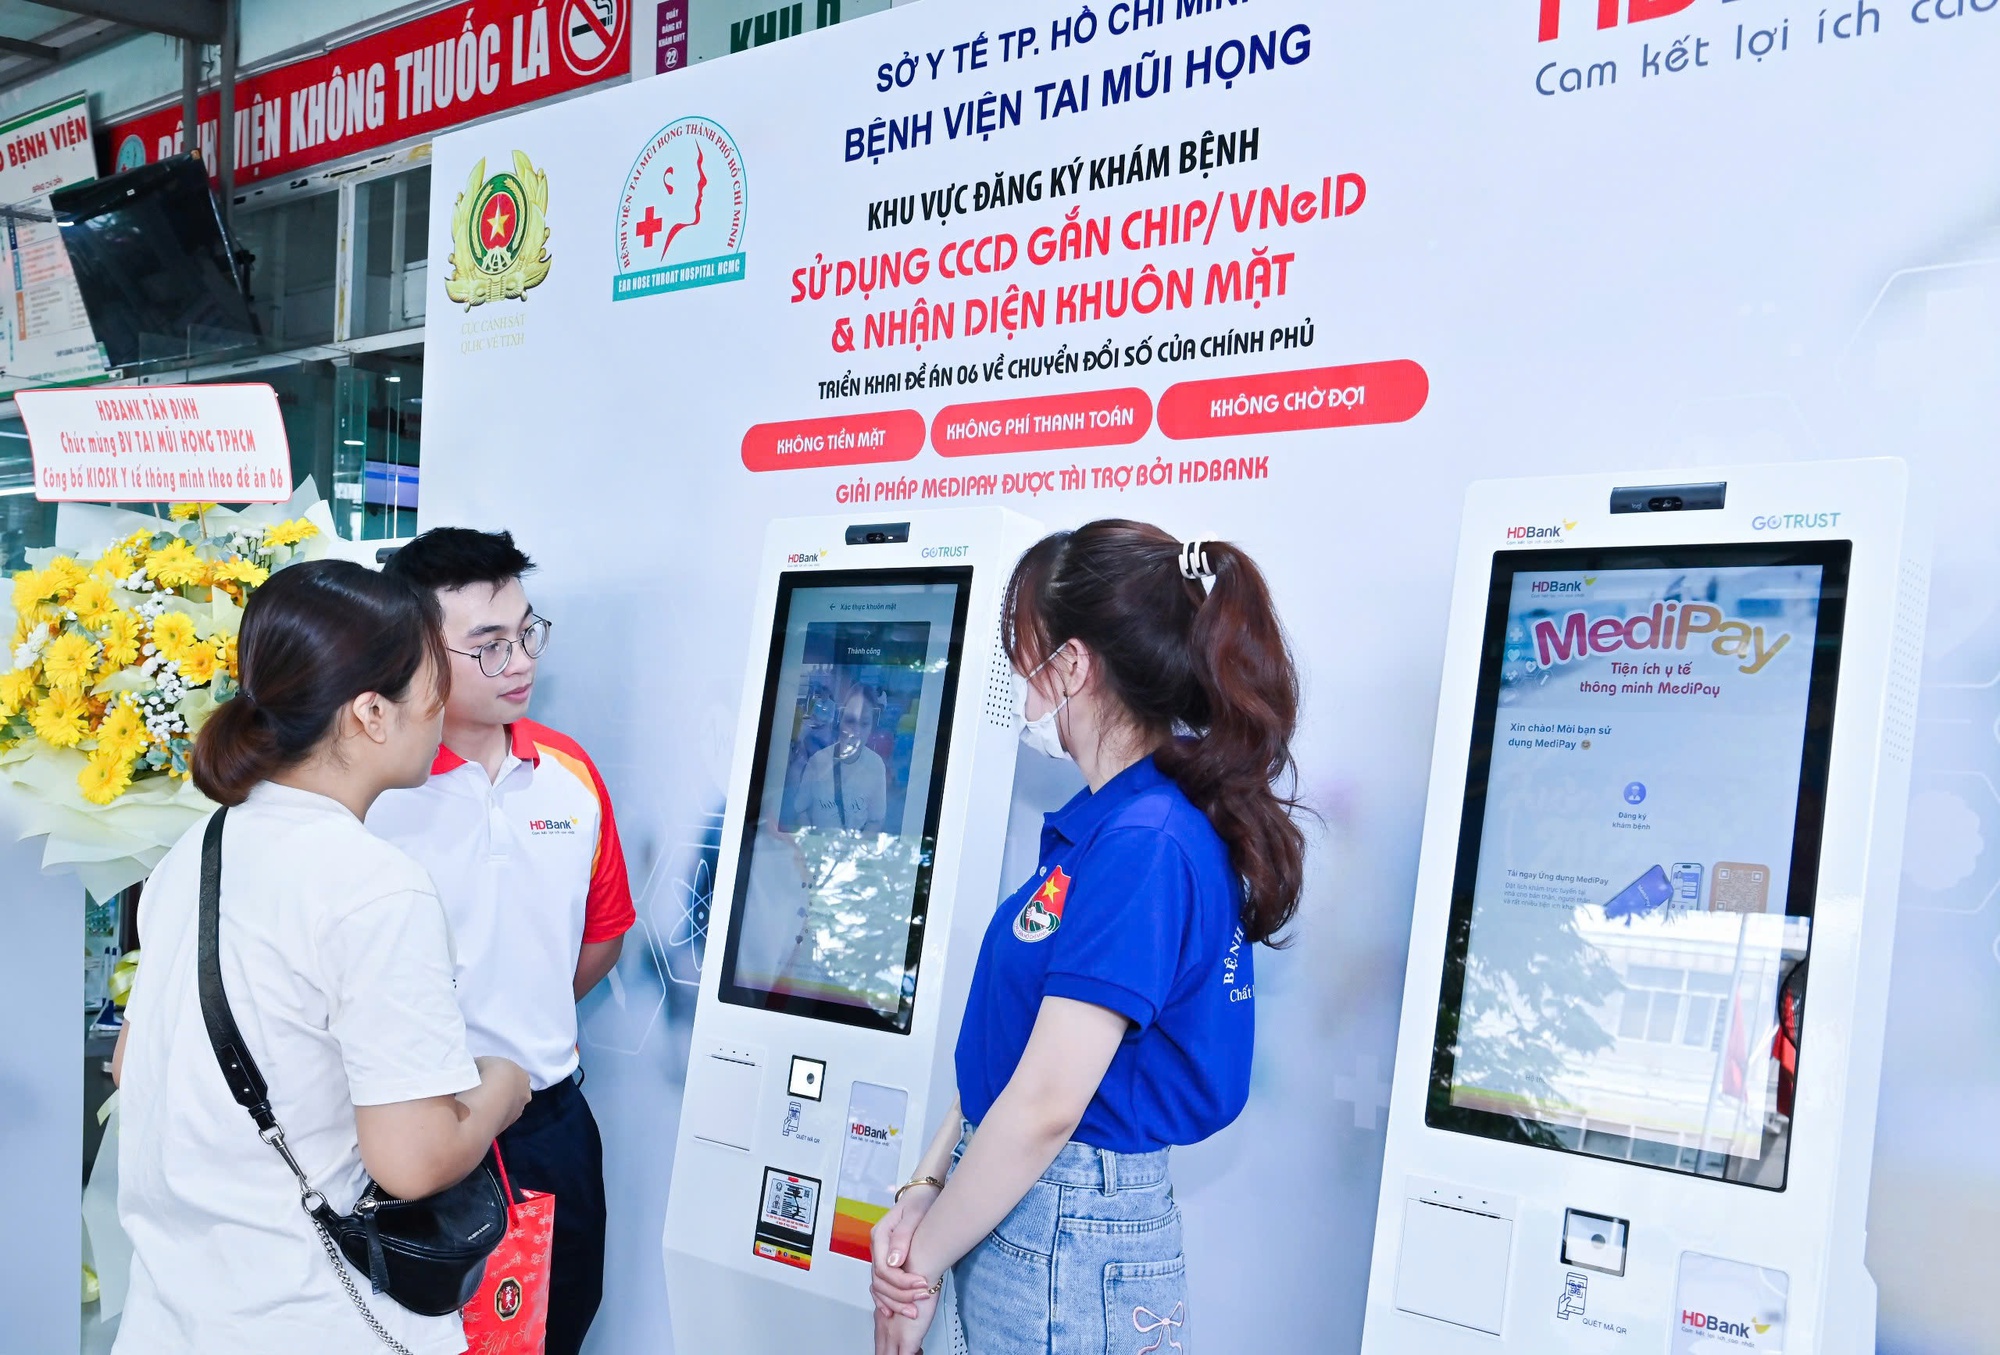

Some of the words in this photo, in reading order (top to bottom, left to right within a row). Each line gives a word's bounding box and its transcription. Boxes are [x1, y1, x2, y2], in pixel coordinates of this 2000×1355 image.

[876, 52, 919, 93] SỞ
[926, 49, 945, 80] Y
[952, 32, 988, 74] TẾ
[998, 27, 1040, 64] TP.
[1051, 4, 1098, 50] HỒ
[1535, 60, 1617, 96] Cam
[1642, 35, 1709, 78] kết
[1735, 18, 1789, 63] lợi
[1817, 0, 1880, 44] ích
[289, 62, 385, 153] KHÔNG
[395, 7, 500, 120] THUỐC
[844, 110, 932, 165] BỆNH
[943, 87, 1022, 142] VIỆN
[1034, 74, 1090, 121] TAI
[1101, 50, 1172, 107] MŨI
[1185, 23, 1312, 91] HỌNG
[7, 131, 48, 170] BỆNH
[49, 115, 87, 152] VIỆN
[657, 126, 683, 149] HỌNG
[685, 122, 716, 142] THÀNH
[628, 169, 642, 193] TAI
[732, 179, 743, 207] CHÍ
[868, 194, 915, 232] KHU
[921, 184, 969, 229] VỰC
[973, 167, 1043, 213] ĐĂNG
[1049, 156, 1084, 197] KÝ
[1089, 144, 1171, 190] KHÁM
[1178, 127, 1260, 179] BỆNH
[726, 208, 741, 248] MINH
[790, 252, 834, 304] SỬ
[834, 247, 929, 302] DỤNG
[938, 233, 1019, 279] CCCD
[1026, 205, 1111, 267] GẮN
[618, 277, 631, 293] EAR
[632, 273, 650, 290] NOSE
[651, 269, 678, 287] THROAT
[679, 263, 715, 282] HOSPITAL
[717, 258, 740, 275] HCMC
[831, 316, 856, 353] &
[864, 297, 955, 352] NHẬN
[964, 284, 1049, 341] DIỆN
[1055, 265, 1194, 325] KHUÔN
[1204, 245, 1296, 311] MẶT
[818, 370, 860, 400] TRIỂN
[864, 373, 901, 395] KHAI
[904, 362, 926, 391] ĐỀ
[928, 365, 952, 389] ÁN
[956, 363, 979, 386] 06
[983, 352, 1004, 382] VỀ
[1007, 343, 1078, 379] CHUYỂN
[1083, 338, 1119, 371] ĐỔI
[1124, 335, 1153, 367] SỐ
[1157, 333, 1195, 363] CỦA
[1200, 328, 1264, 358] CHÍNH
[1270, 317, 1314, 350] PHỦ
[95, 399, 143, 421] HDBANK
[1210, 393, 1279, 419] KHÔNG
[1283, 385, 1326, 412] CHỜ
[1327, 385, 1365, 411] ĐỢI
[946, 418, 1001, 441] KHÔNG
[1005, 412, 1031, 435] PHÍ
[1034, 411, 1085, 433] THANH
[1089, 405, 1134, 429] TOÁN
[60, 430, 86, 454] Chúc
[117, 431, 133, 453] BV
[135, 430, 155, 453] TAI
[157, 425, 178, 453] MŨI
[180, 429, 215, 457] HỌNG
[216, 429, 256, 452] TPHCM
[777, 435, 824, 456] KHÔNG
[827, 426, 854, 450] TIỀN
[858, 428, 886, 451] MẶT
[43, 466, 67, 492] Công
[70, 463, 83, 488] bố
[87, 467, 118, 488] KIOSK
[120, 467, 127, 488] Y
[131, 463, 142, 488] tế
[145, 467, 176, 492] thông
[179, 467, 205, 488] minh
[208, 467, 232, 488] theo
[236, 463, 249, 488] đề
[254, 465, 266, 488] án
[269, 468, 283, 488] 06
[836, 476, 870, 504] GIẢI
[875, 476, 918, 503] PHÁP
[922, 474, 997, 499] MEDIPAY
[1002, 470, 1054, 498] ĐƯỢC
[1059, 464, 1086, 491] TÀI
[1091, 466, 1133, 492] TRỢ
[1136, 456, 1172, 486] BỞI
[1178, 455, 1269, 484] HDBANK
[1507, 526, 1562, 538] HDBank
[788, 553, 818, 563] HDBank
[1531, 580, 1582, 592] HDBank
[1534, 602, 1791, 675] MediPay
[1611, 661, 1638, 676] Tiện
[1643, 662, 1660, 675] ích
[1665, 665, 1673, 677] y
[1677, 661, 1692, 675] tế
[1580, 681, 1617, 696] thông
[1621, 681, 1653, 694] minh
[1657, 682, 1720, 698] MediPay
[1508, 738, 1532, 749] dụng
[1534, 739, 1577, 750] MediPay
[1510, 723, 1526, 732] Xin
[1528, 723, 1555, 733] chào!
[1577, 725, 1596, 735] bạn
[529, 819, 571, 830] HDBank
[1576, 875, 1609, 886] MediPay
[1223, 925, 1245, 985] BỆNH
[1229, 984, 1252, 1003] Chất
[851, 1123, 888, 1140] HDBank
[1582, 1317, 1602, 1329] QUÉT
[1603, 1321, 1615, 1332] MÃ
[1616, 1325, 1627, 1335] QR
[1682, 1309, 1750, 1339] HDBank
